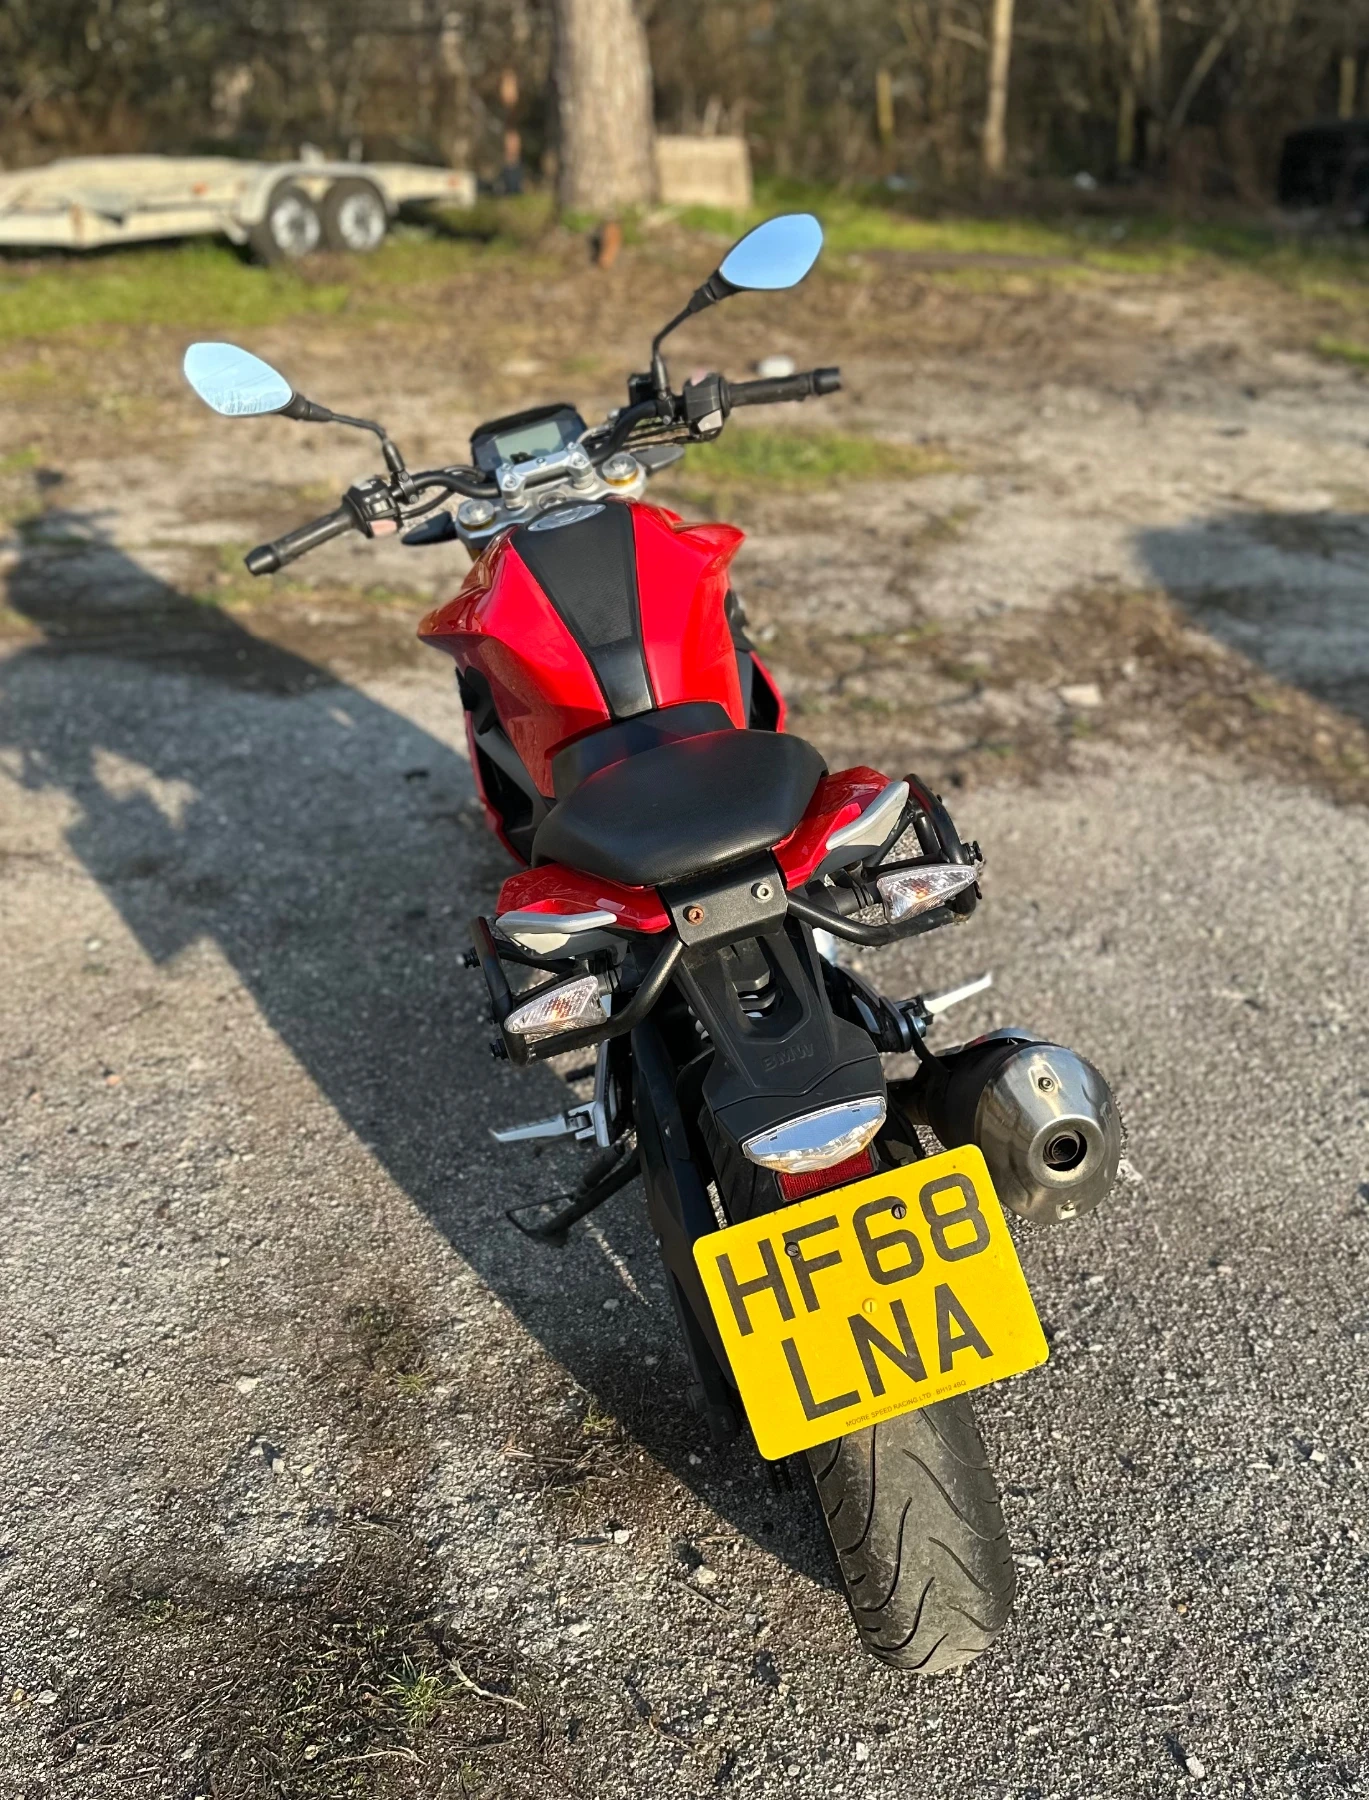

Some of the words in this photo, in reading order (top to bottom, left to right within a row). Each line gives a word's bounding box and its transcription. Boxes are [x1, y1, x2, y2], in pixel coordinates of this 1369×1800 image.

[762, 1043, 814, 1072] BMW
[716, 1173, 990, 1337] HF68
[782, 1283, 994, 1421] LNA
[845, 1414, 871, 1427] MOORE
[871, 1405, 893, 1418] SPEED
[893, 1397, 919, 1410] RACING
[919, 1391, 932, 1401] LTD
[936, 1384, 953, 1395] BH12
